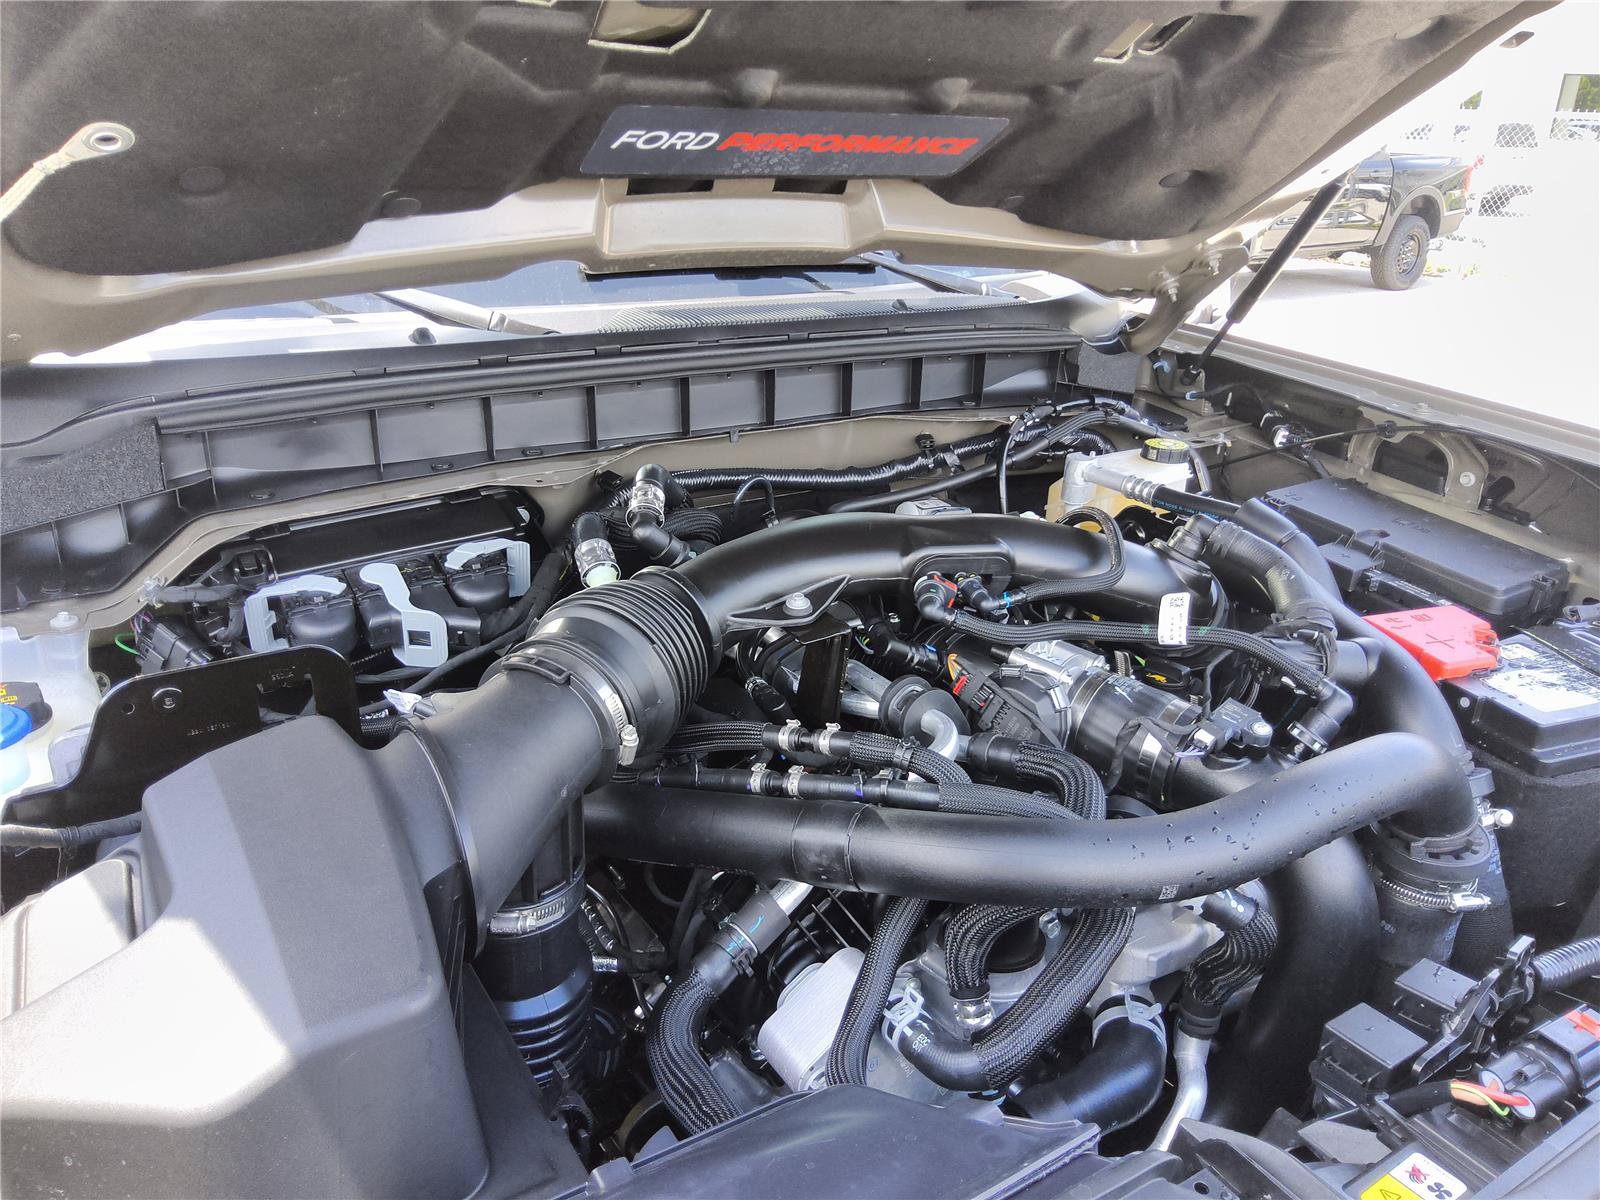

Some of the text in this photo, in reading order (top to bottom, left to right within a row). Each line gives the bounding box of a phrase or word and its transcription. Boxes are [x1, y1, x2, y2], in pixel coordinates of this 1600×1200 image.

[610, 130, 979, 155] FORD PERFORMANCE
[916, 1033, 931, 1047] EOC
